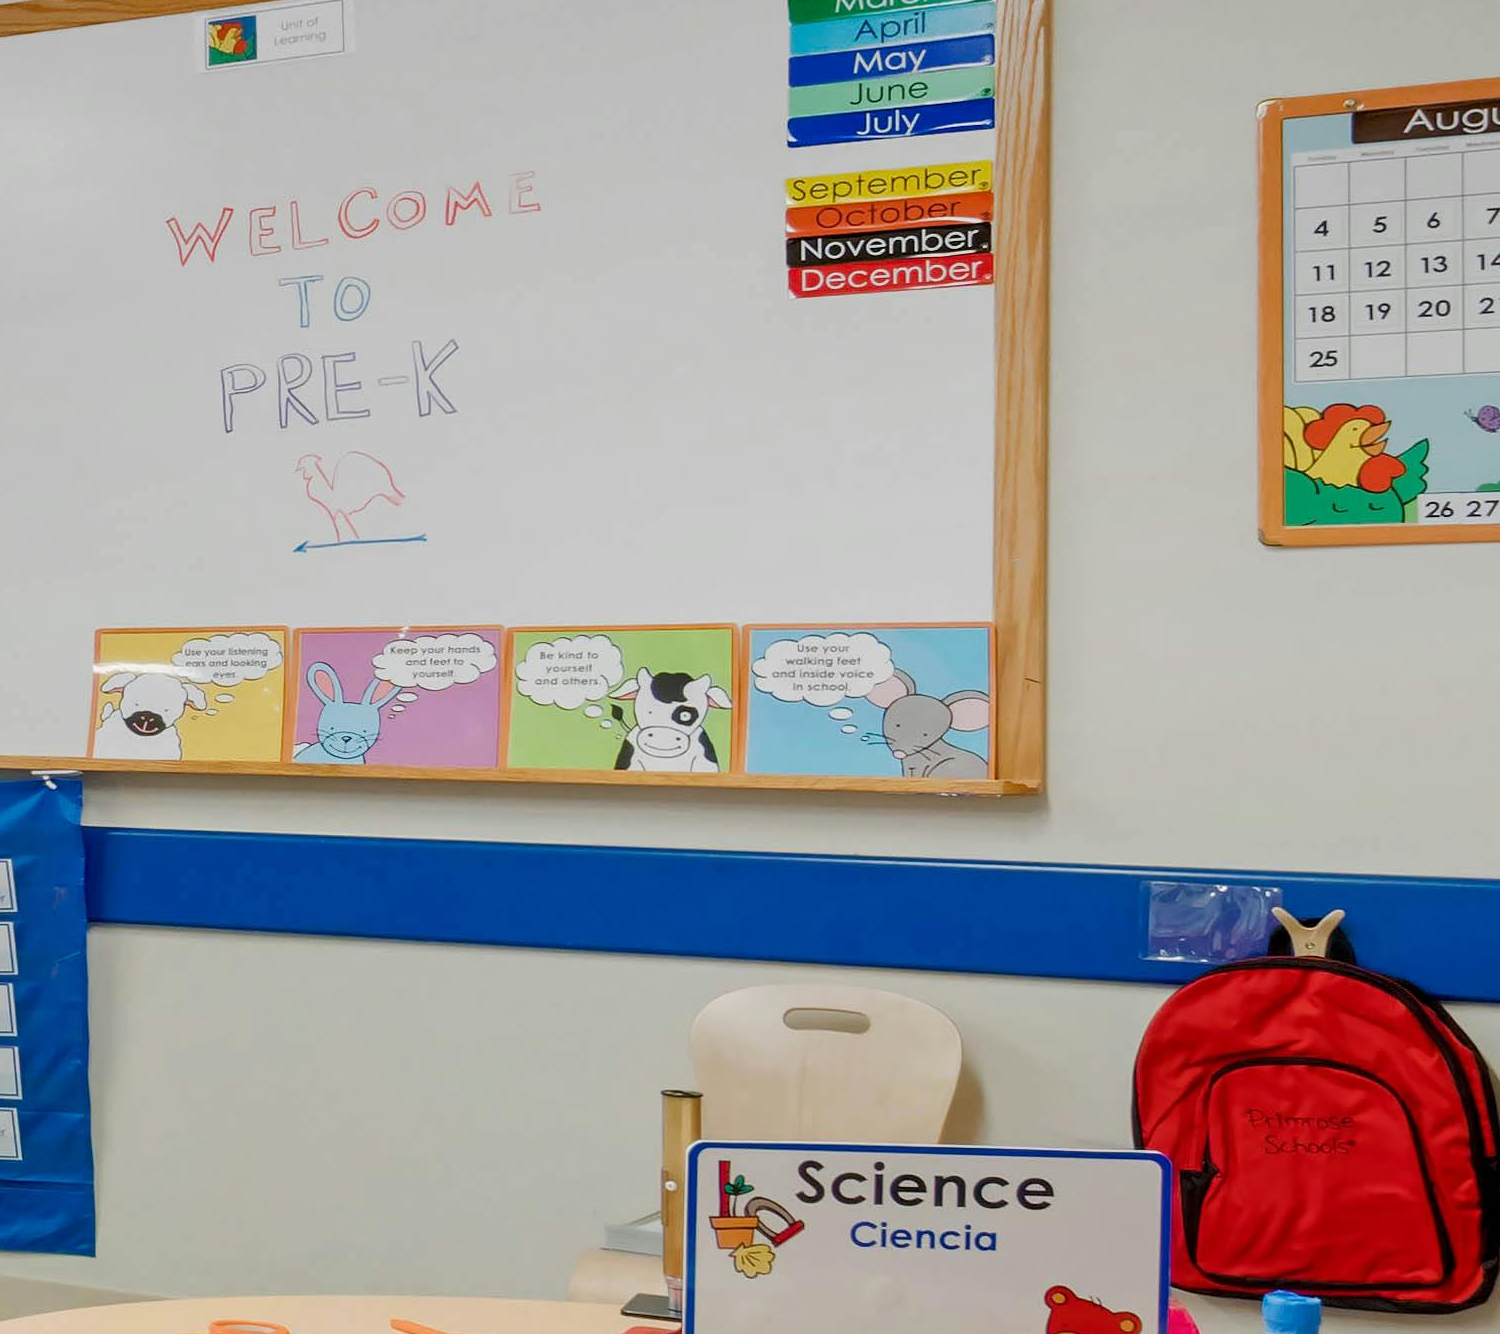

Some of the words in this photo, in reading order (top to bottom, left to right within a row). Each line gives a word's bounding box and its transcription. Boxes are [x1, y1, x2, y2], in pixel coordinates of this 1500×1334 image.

[280, 18, 303, 32] Unit
[306, 16, 320, 29] of
[855, 11, 927, 44] April
[274, 29, 327, 47] Learning
[853, 48, 927, 74] May
[850, 78, 928, 105] June
[856, 110, 921, 136] July
[792, 166, 981, 203] September
[165, 170, 541, 267] WELCOME
[816, 198, 961, 229] October
[1314, 220, 1329, 237] 4
[1373, 216, 1387, 234] 5
[1427, 212, 1441, 229] 6
[801, 226, 979, 262] November
[802, 260, 983, 293] December
[1312, 264, 1336, 281] 11
[1364, 261, 1391, 279] 12
[1420, 257, 1448, 274] 13
[278, 275, 371, 328] TO
[1308, 306, 1336, 323] 18
[1365, 303, 1391, 321] 19
[1418, 301, 1451, 318] 20
[1309, 351, 1338, 368] 25
[220, 338, 459, 433] PRE-K
[1425, 501, 1454, 518] 26
[1467, 500, 1498, 517] 27
[184, 648, 199, 657] Use
[204, 649, 224, 659] your
[228, 647, 268, 659] listening
[390, 646, 417, 658] Keep
[421, 647, 444, 657] your
[448, 645, 481, 654] hands
[540, 651, 553, 660] Be
[558, 650, 582, 660] kind
[587, 652, 598, 660] to
[798, 644, 820, 653] Use
[826, 645, 850, 656] your
[186, 661, 204, 669] ears
[208, 660, 227, 668] and
[230, 660, 267, 671] looking
[406, 658, 426, 667] and
[430, 657, 449, 666] feet
[454, 658, 464, 666] to
[546, 663, 593, 675] yourself
[785, 656, 833, 668] walking
[839, 656, 861, 666] feet
[535, 676, 557, 686] and
[772, 669, 794, 678] and
[799, 669, 834, 679] inside
[838, 670, 874, 679] voice
[793, 682, 802, 692] in
[796, 1159, 1055, 1211] Science
[850, 1220, 997, 1252] Ciencia
